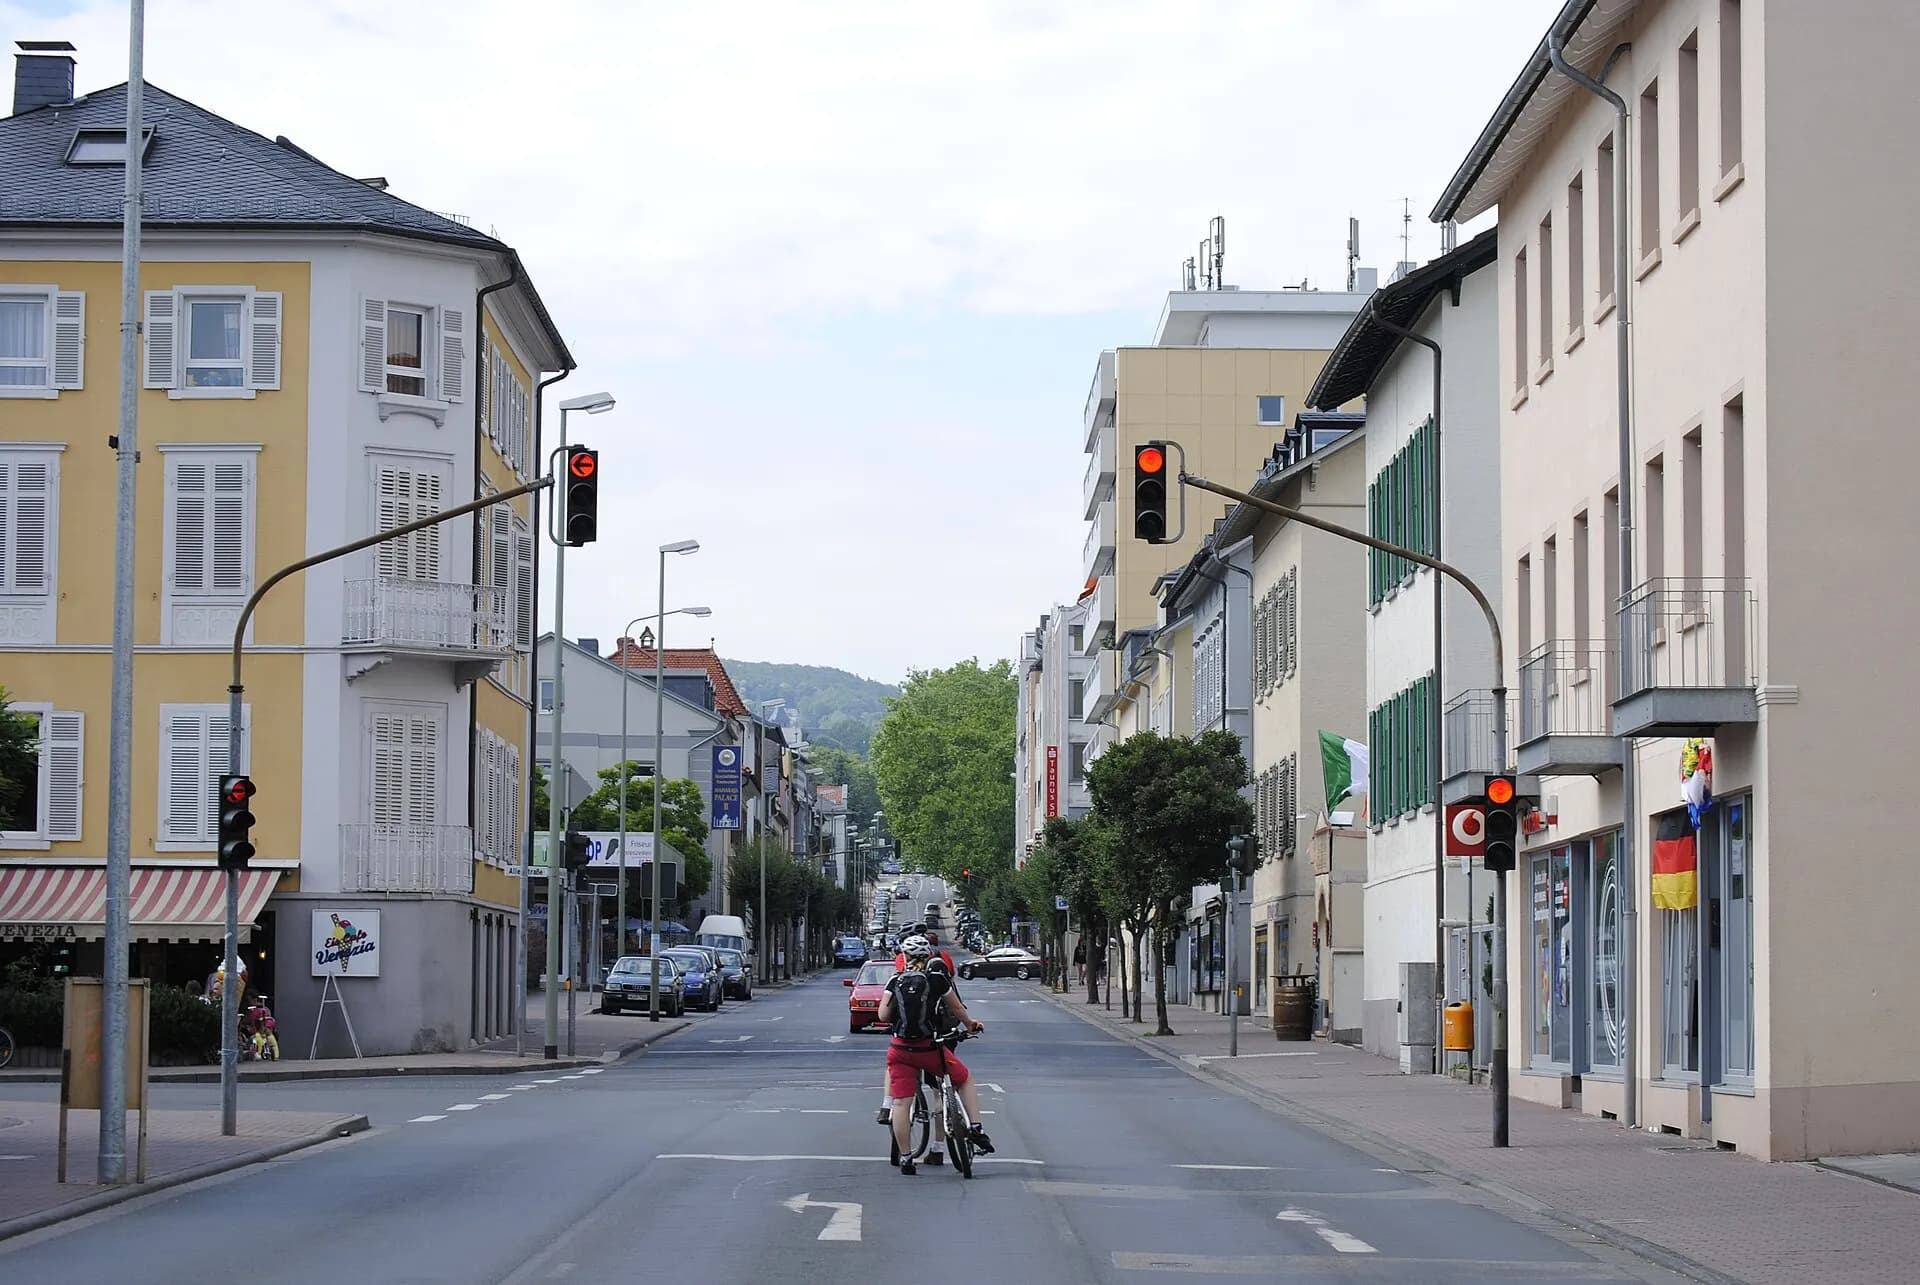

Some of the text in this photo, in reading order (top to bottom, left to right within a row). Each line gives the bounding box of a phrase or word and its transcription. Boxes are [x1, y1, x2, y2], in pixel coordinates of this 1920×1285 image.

[1049, 760, 1057, 801] Taunus
[586, 840, 602, 861] OP
[508, 867, 544, 876] Alletraße
[316, 941, 376, 965] Venezia
